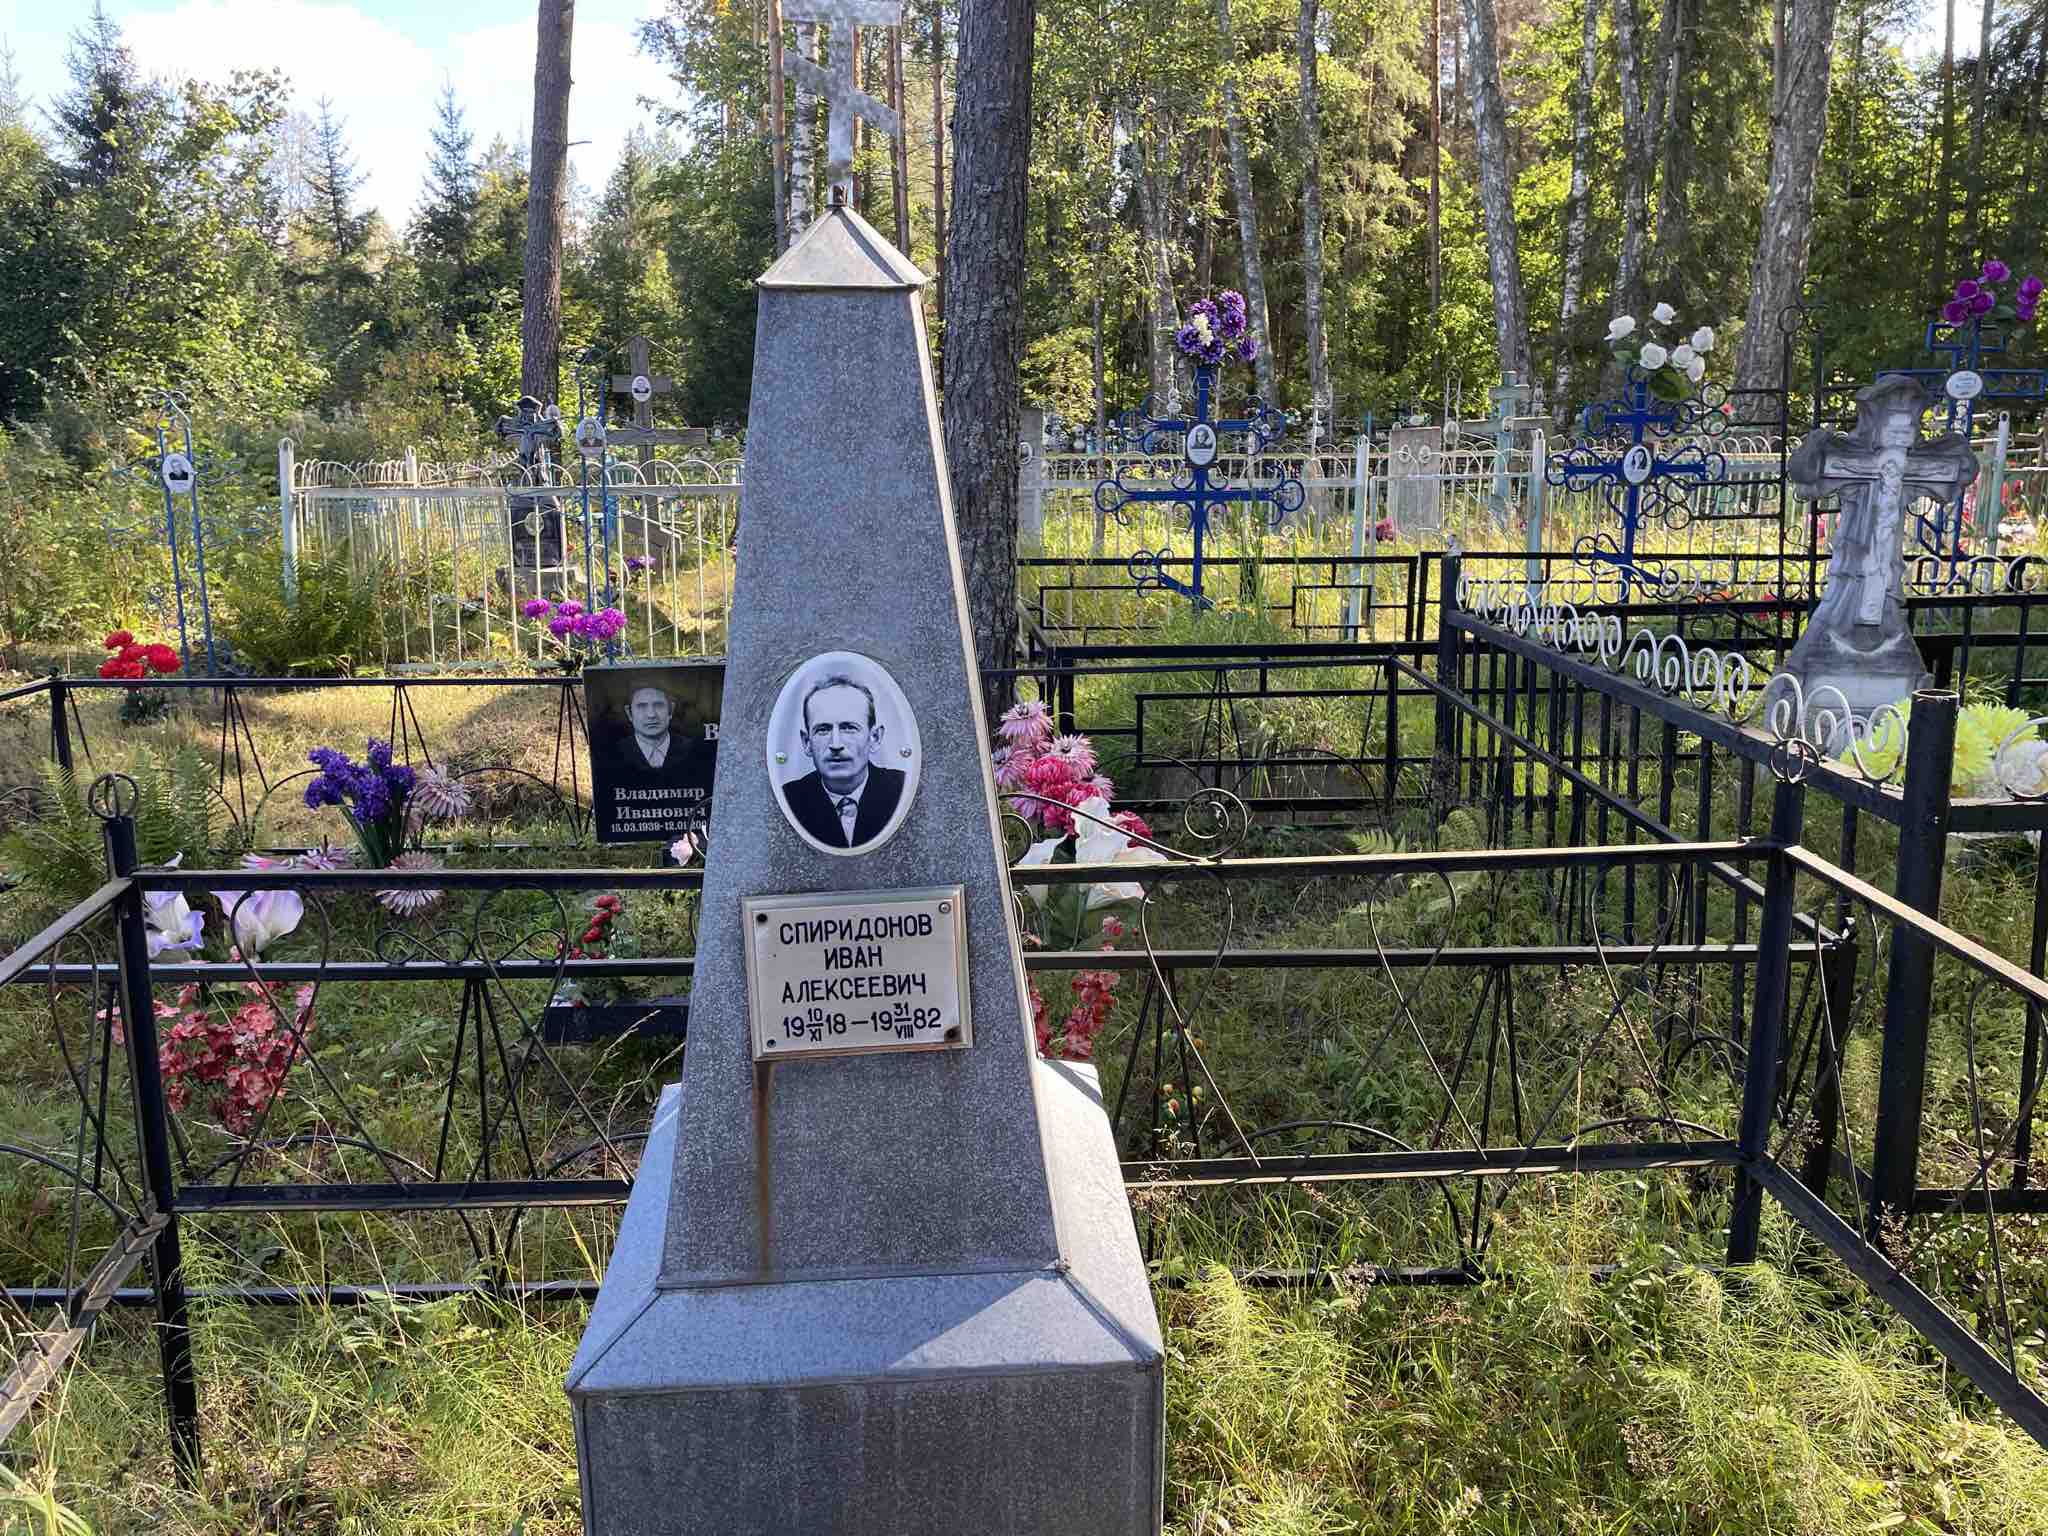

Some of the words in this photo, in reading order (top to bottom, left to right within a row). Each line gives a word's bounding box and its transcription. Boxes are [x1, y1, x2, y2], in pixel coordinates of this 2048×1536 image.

[614, 787, 705, 801] Владимир
[780, 914, 932, 944] СПИРИДОНОВ
[824, 946, 883, 970] ИВАН
[782, 973, 927, 1004] АЛЕКСЕЕВИЧ
